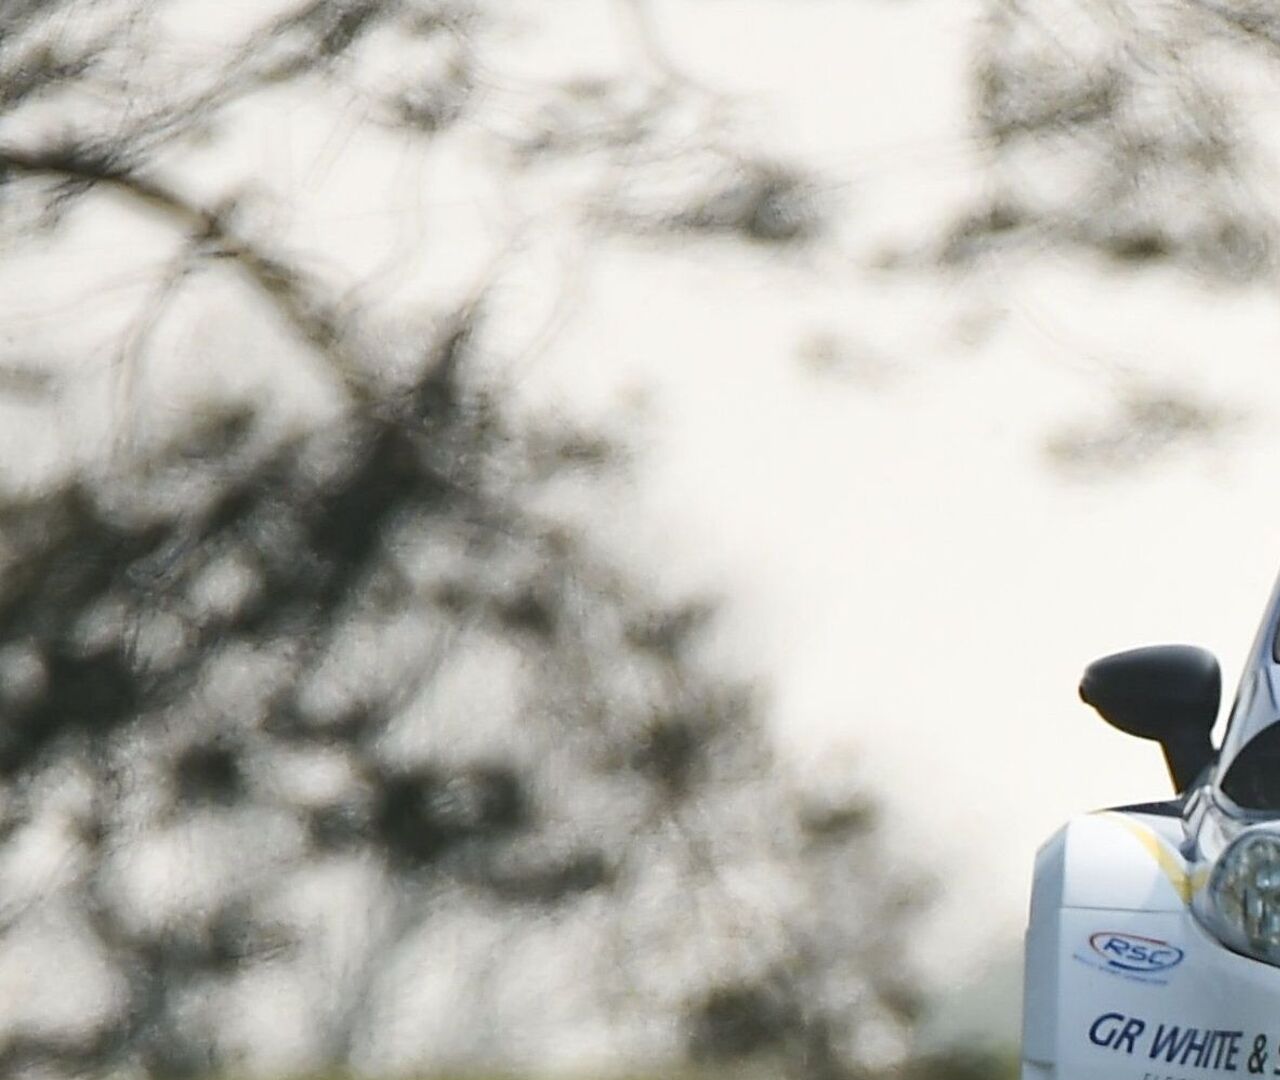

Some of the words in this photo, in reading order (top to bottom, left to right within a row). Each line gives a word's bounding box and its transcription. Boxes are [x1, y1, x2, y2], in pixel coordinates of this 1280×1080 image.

[1103, 937, 1174, 966] RSC
[1088, 1011, 1146, 1054] GR
[1149, 1023, 1244, 1072] WHITE
[1247, 1033, 1269, 1075] &
